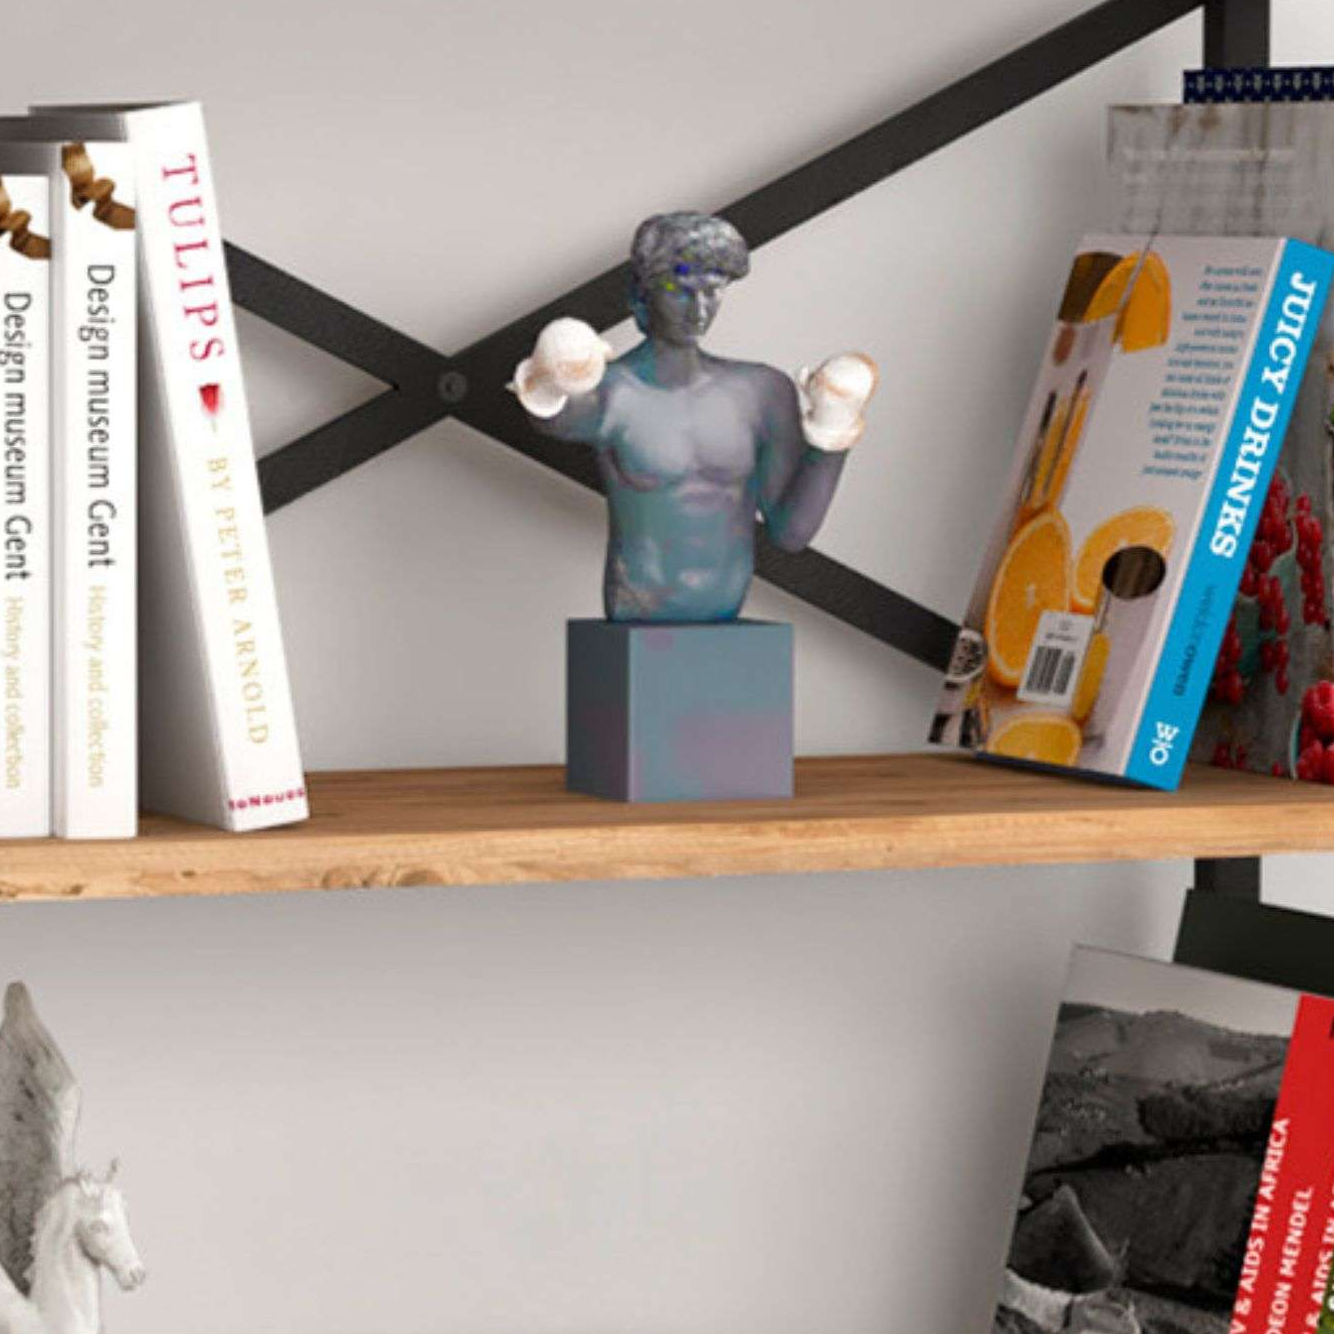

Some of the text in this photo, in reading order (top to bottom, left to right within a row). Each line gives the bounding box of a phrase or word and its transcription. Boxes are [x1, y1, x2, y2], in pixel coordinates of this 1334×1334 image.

[162, 152, 226, 363] TULIPS
[1260, 270, 1317, 395] JUICY
[4, 393, 27, 505] museum
[1210, 396, 1279, 559] DRINKS
[4, 514, 33, 581] Gent
[77, 264, 117, 788] Design museum Gent History and collection
[206, 456, 270, 745] BY PETER ARNOLD
[1259, 1117, 1291, 1201] AFRICA
[1240, 1237, 1265, 1294] AIDS
[1250, 1204, 1272, 1234] IN
[1279, 1185, 1314, 1279] MENDEL
[1233, 1297, 1252, 1316] &
